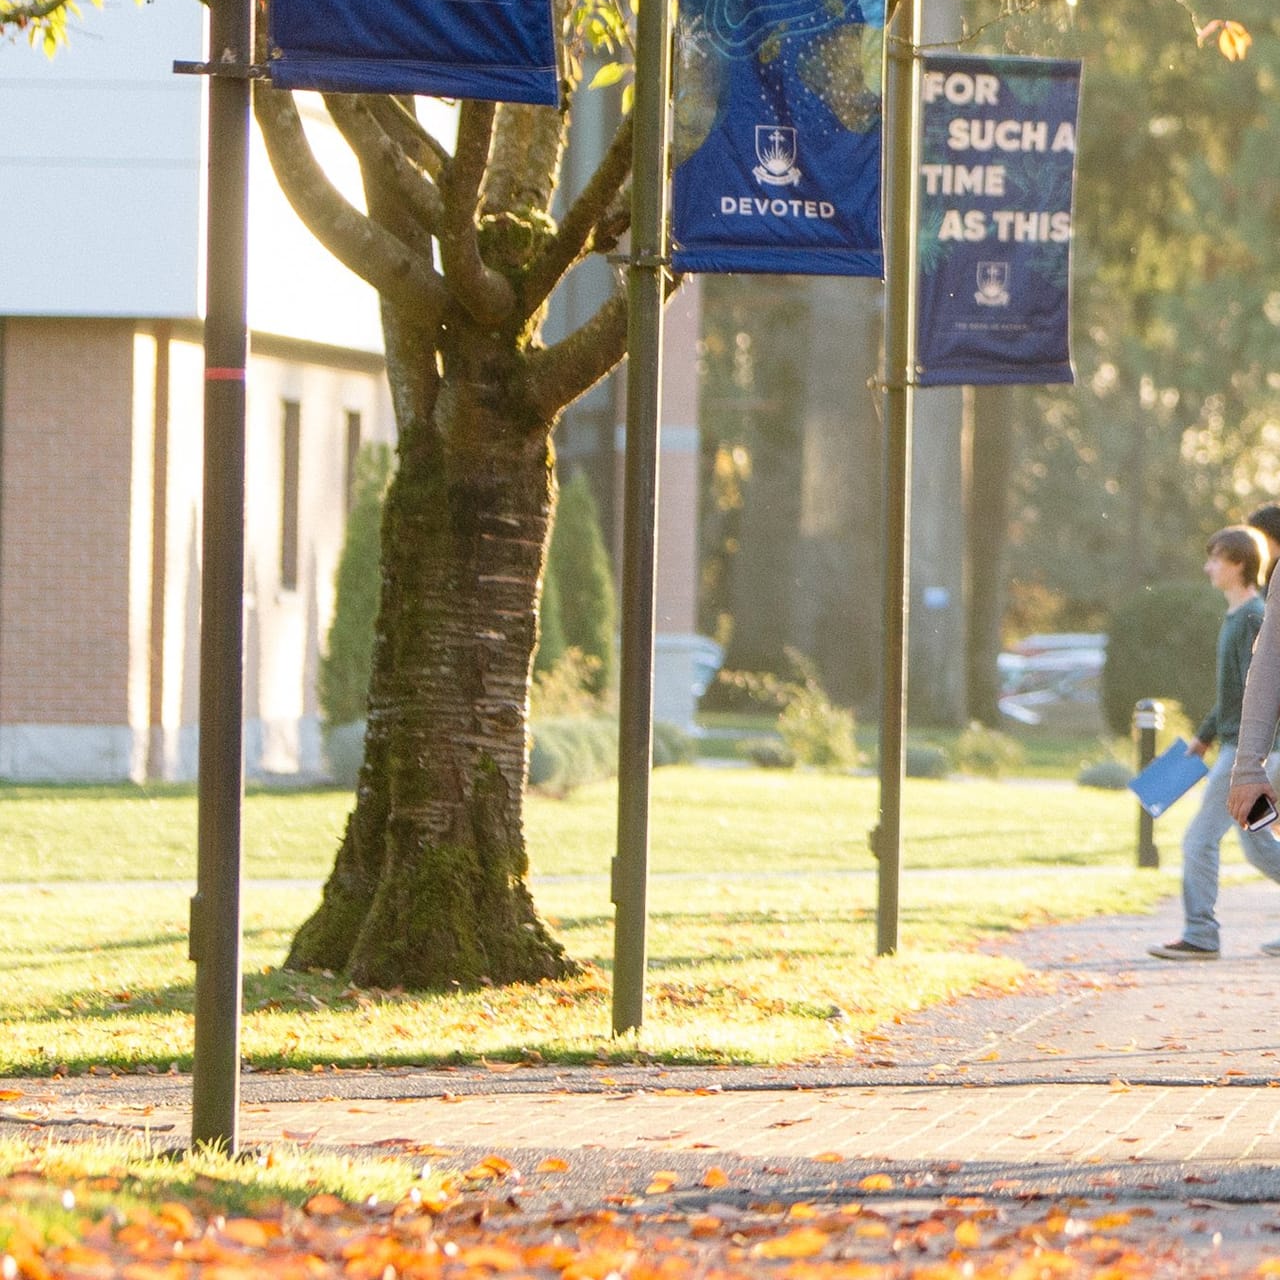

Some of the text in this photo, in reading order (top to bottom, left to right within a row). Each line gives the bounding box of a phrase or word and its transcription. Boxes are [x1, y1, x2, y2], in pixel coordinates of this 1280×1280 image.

[922, 72, 1000, 105] FOR
[947, 118, 1076, 154] SUCH A
[921, 164, 1006, 197] TIME
[721, 196, 836, 219] DEVOTED
[938, 209, 1072, 243] AS THIS
